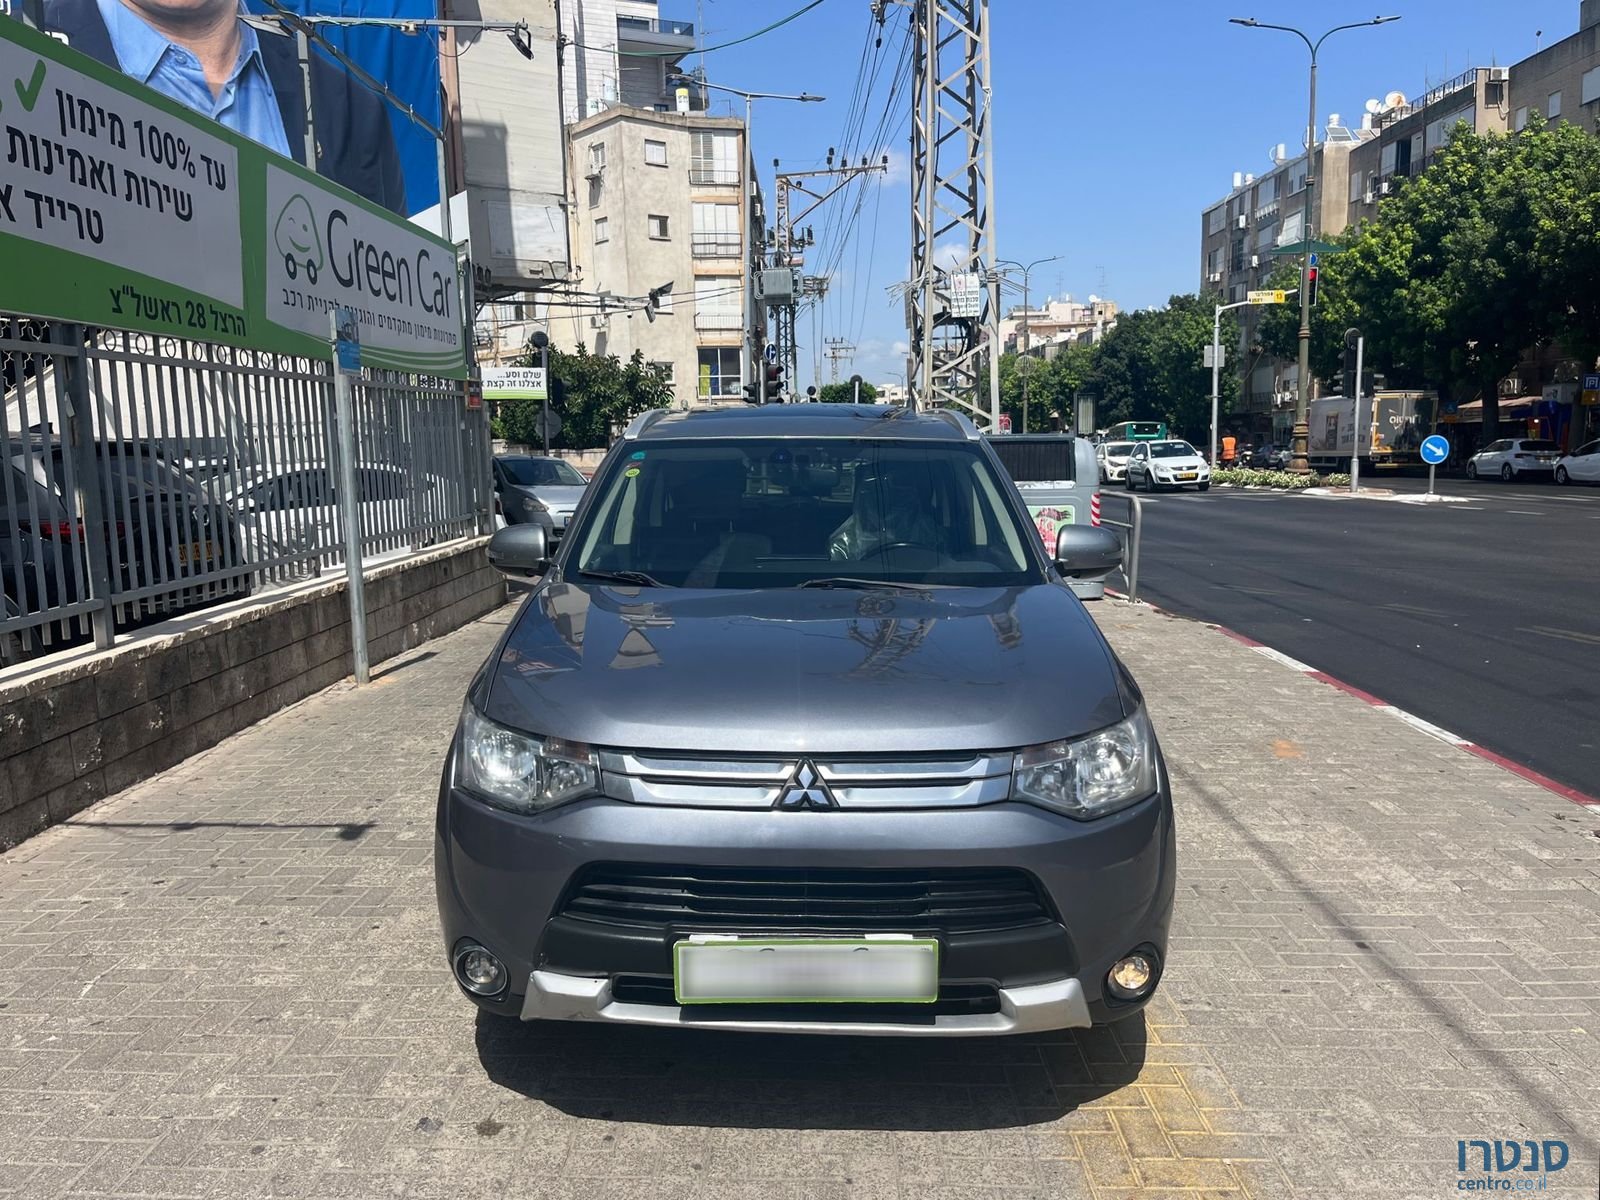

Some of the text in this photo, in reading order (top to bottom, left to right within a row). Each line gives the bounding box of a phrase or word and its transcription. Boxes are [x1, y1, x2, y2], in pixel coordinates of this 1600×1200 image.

[55, 88, 226, 191] עד 100% מימון
[6, 125, 193, 222] שירות ואמינות
[24, 189, 104, 244] טרייד
[327, 209, 452, 318] Green Car
[282, 288, 304, 309] רכב
[185, 300, 207, 329] 28
[209, 303, 246, 337] הרצל
[378, 314, 413, 336] מתקדמים
[414, 323, 432, 340] מימון
[487, 380, 505, 389] קצת
[519, 379, 542, 388] אצלנו
[523, 370, 542, 378] שלם
